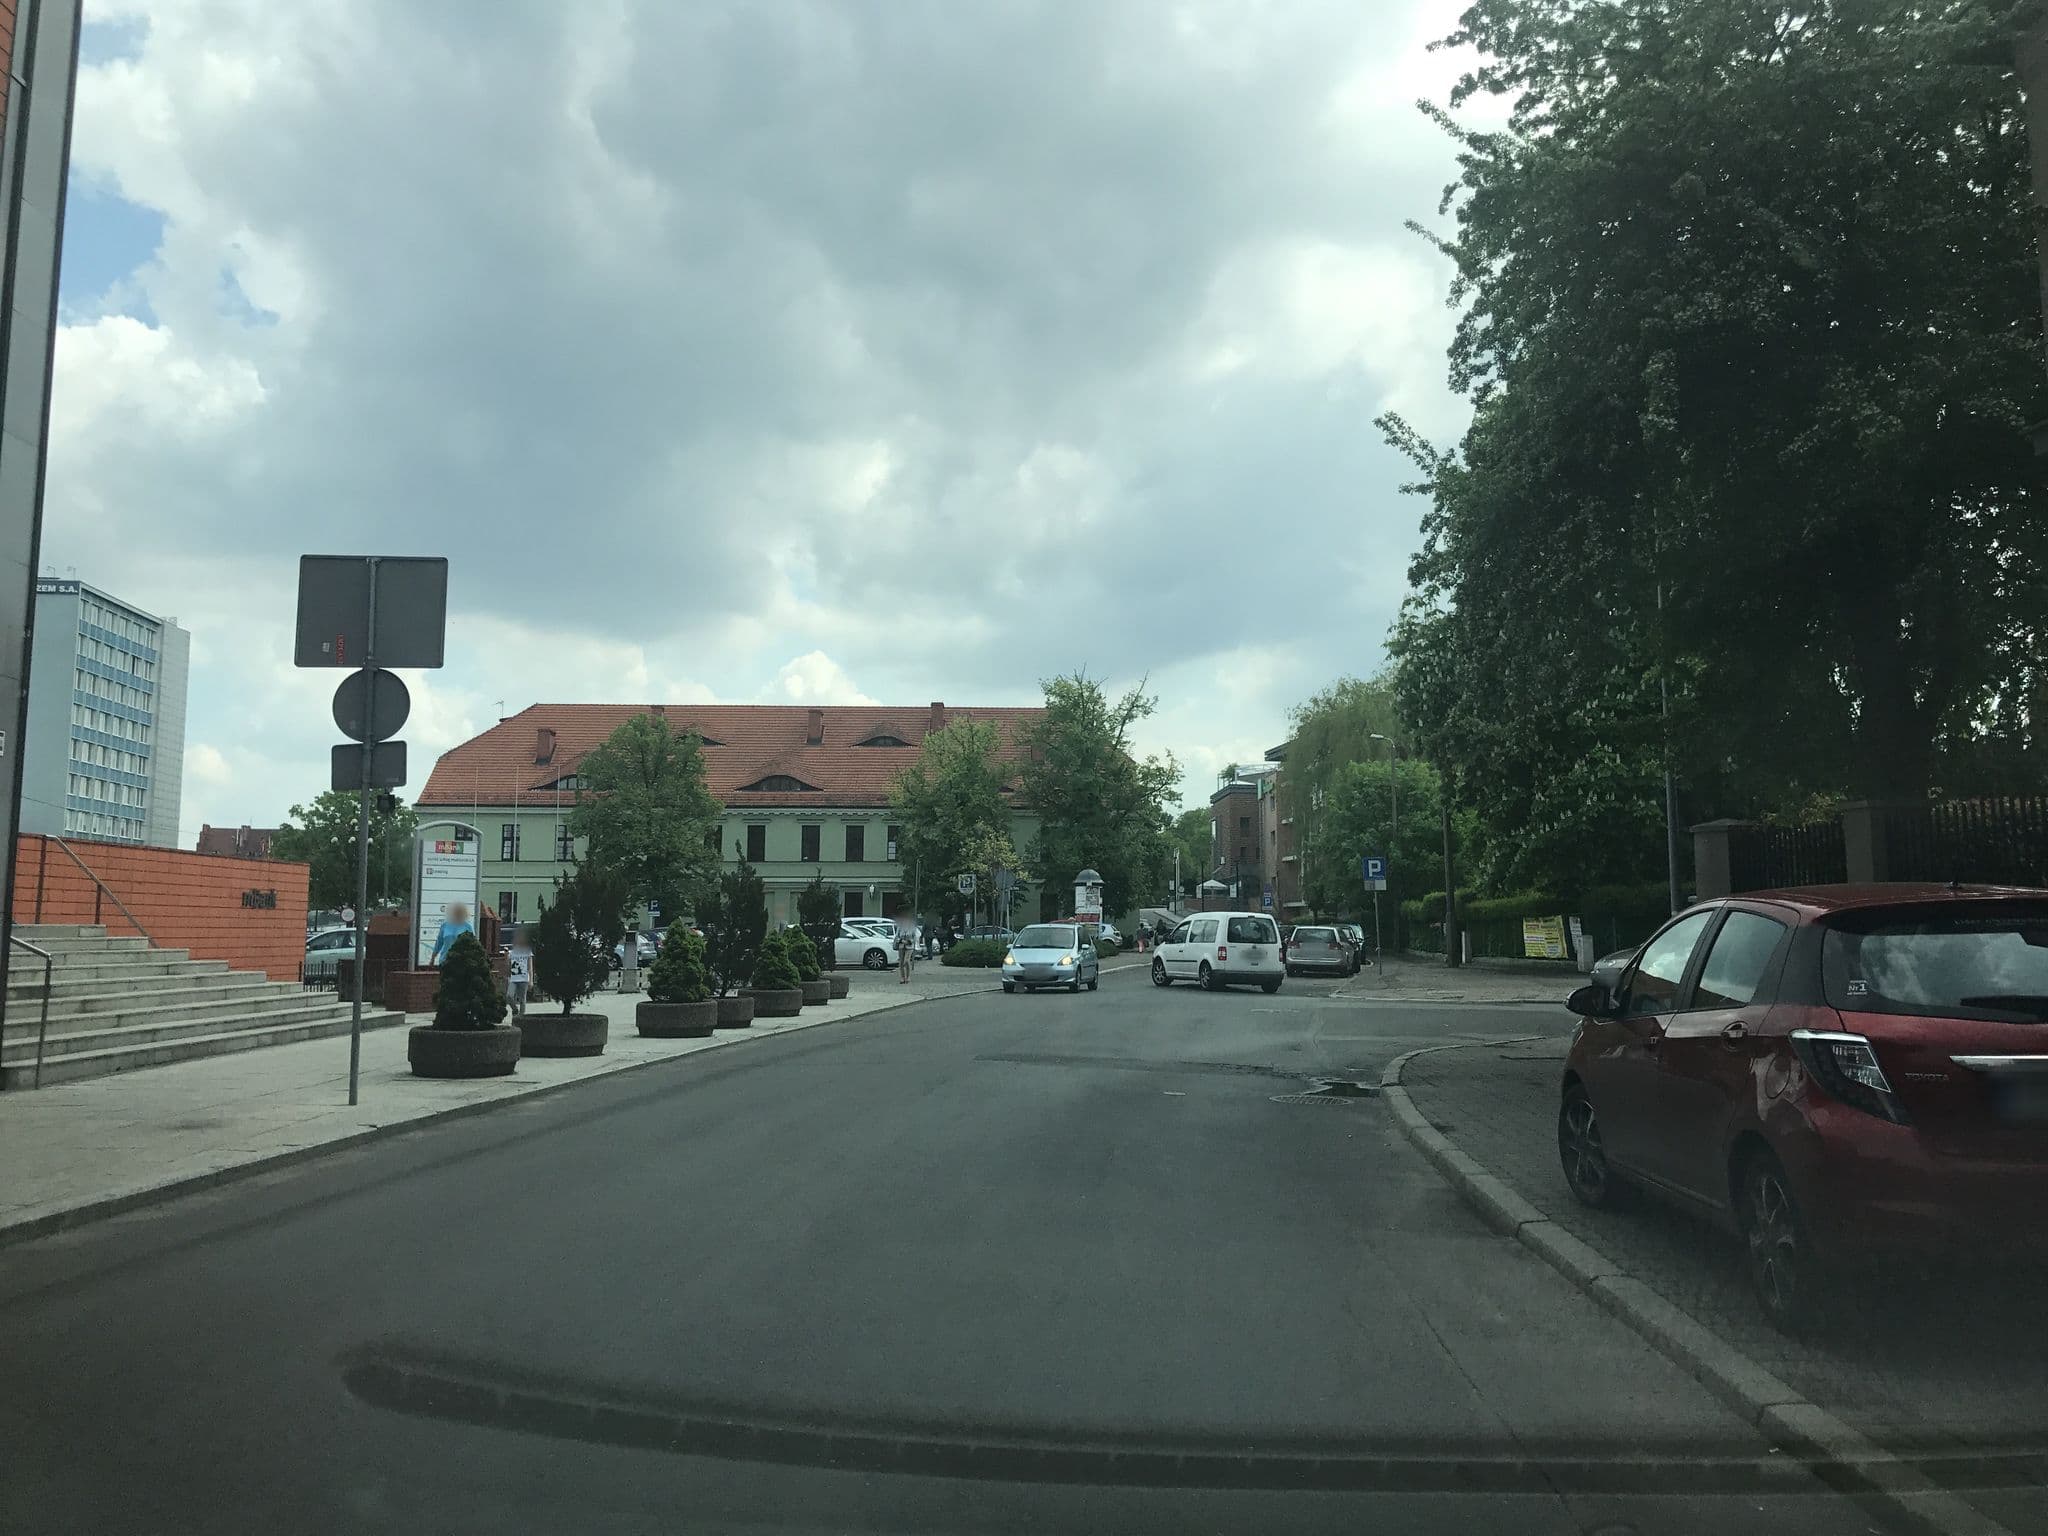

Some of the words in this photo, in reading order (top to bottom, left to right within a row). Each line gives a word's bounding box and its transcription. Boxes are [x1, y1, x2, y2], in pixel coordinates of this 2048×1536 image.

[59, 585, 78, 593] S.A.
[1368, 860, 1381, 877] P
[650, 900, 658, 910] P
[1264, 898, 1271, 906] P
